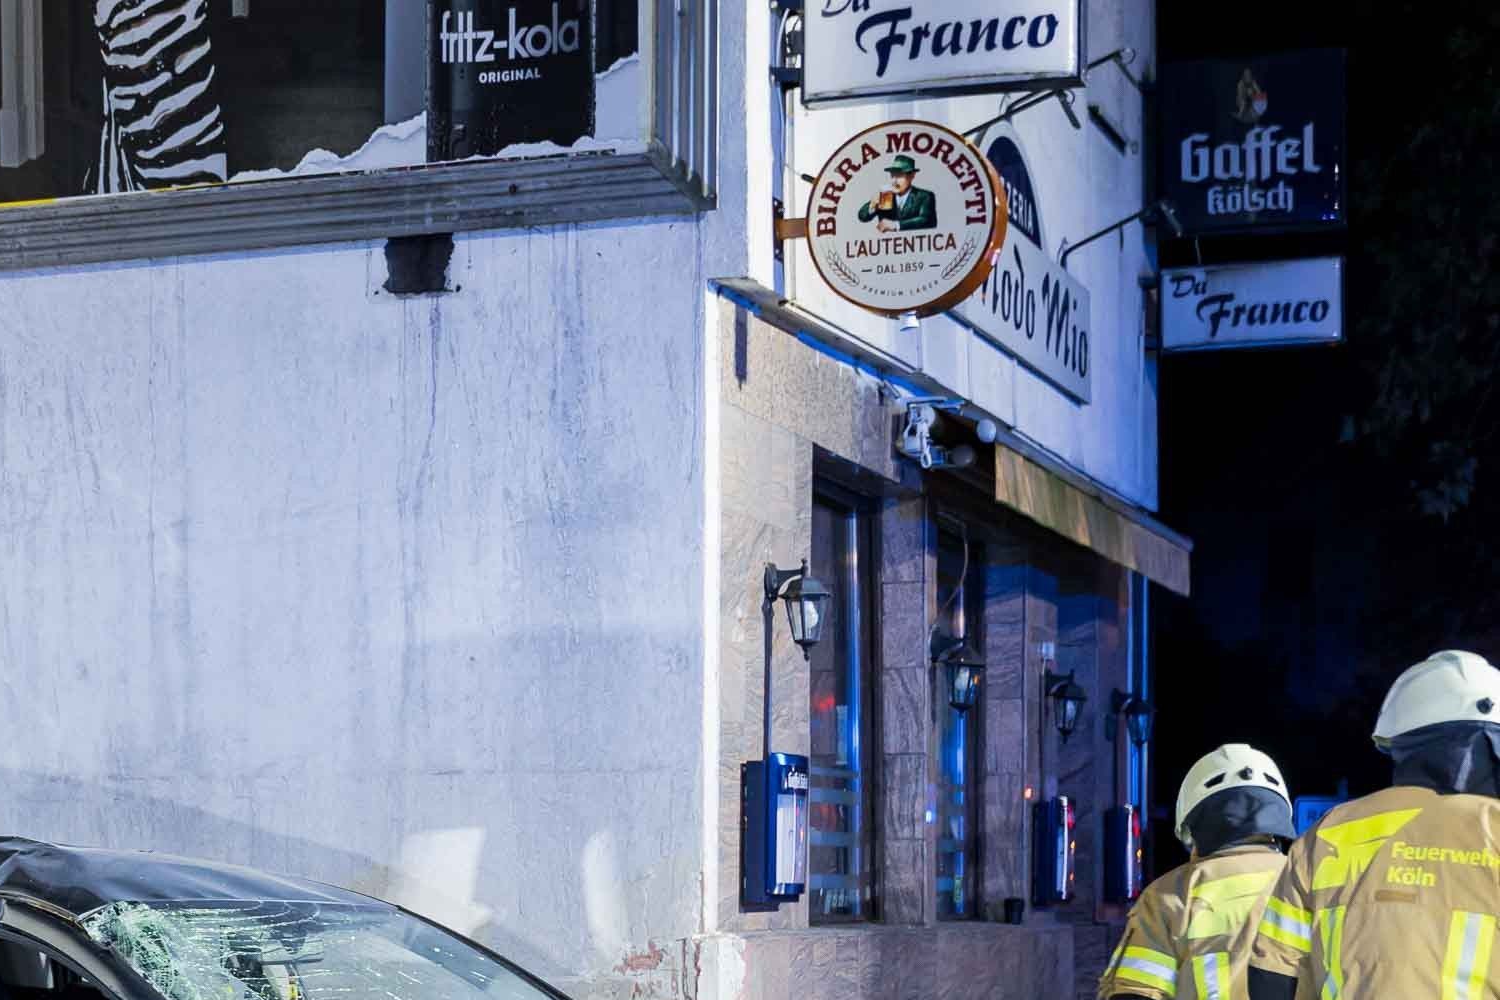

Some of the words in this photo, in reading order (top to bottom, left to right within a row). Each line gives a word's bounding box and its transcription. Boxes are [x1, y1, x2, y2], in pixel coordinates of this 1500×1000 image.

[439, 2, 580, 63] fritz-kola
[855, 7, 1059, 78] Franco
[478, 67, 541, 84] ORIGINAL
[1180, 121, 1323, 183] Gaffel
[816, 142, 881, 238] BIRRA
[886, 131, 987, 226] MORETTI
[1207, 180, 1295, 214] Kölsch
[845, 233, 958, 259] L'AUTENTICA
[876, 263, 898, 275] DAL
[899, 261, 925, 273] 1859
[1170, 274, 1207, 299] Da
[1042, 271, 1088, 379] Mio
[1196, 293, 1331, 338] Franco
[1386, 866, 1437, 888] Köln
